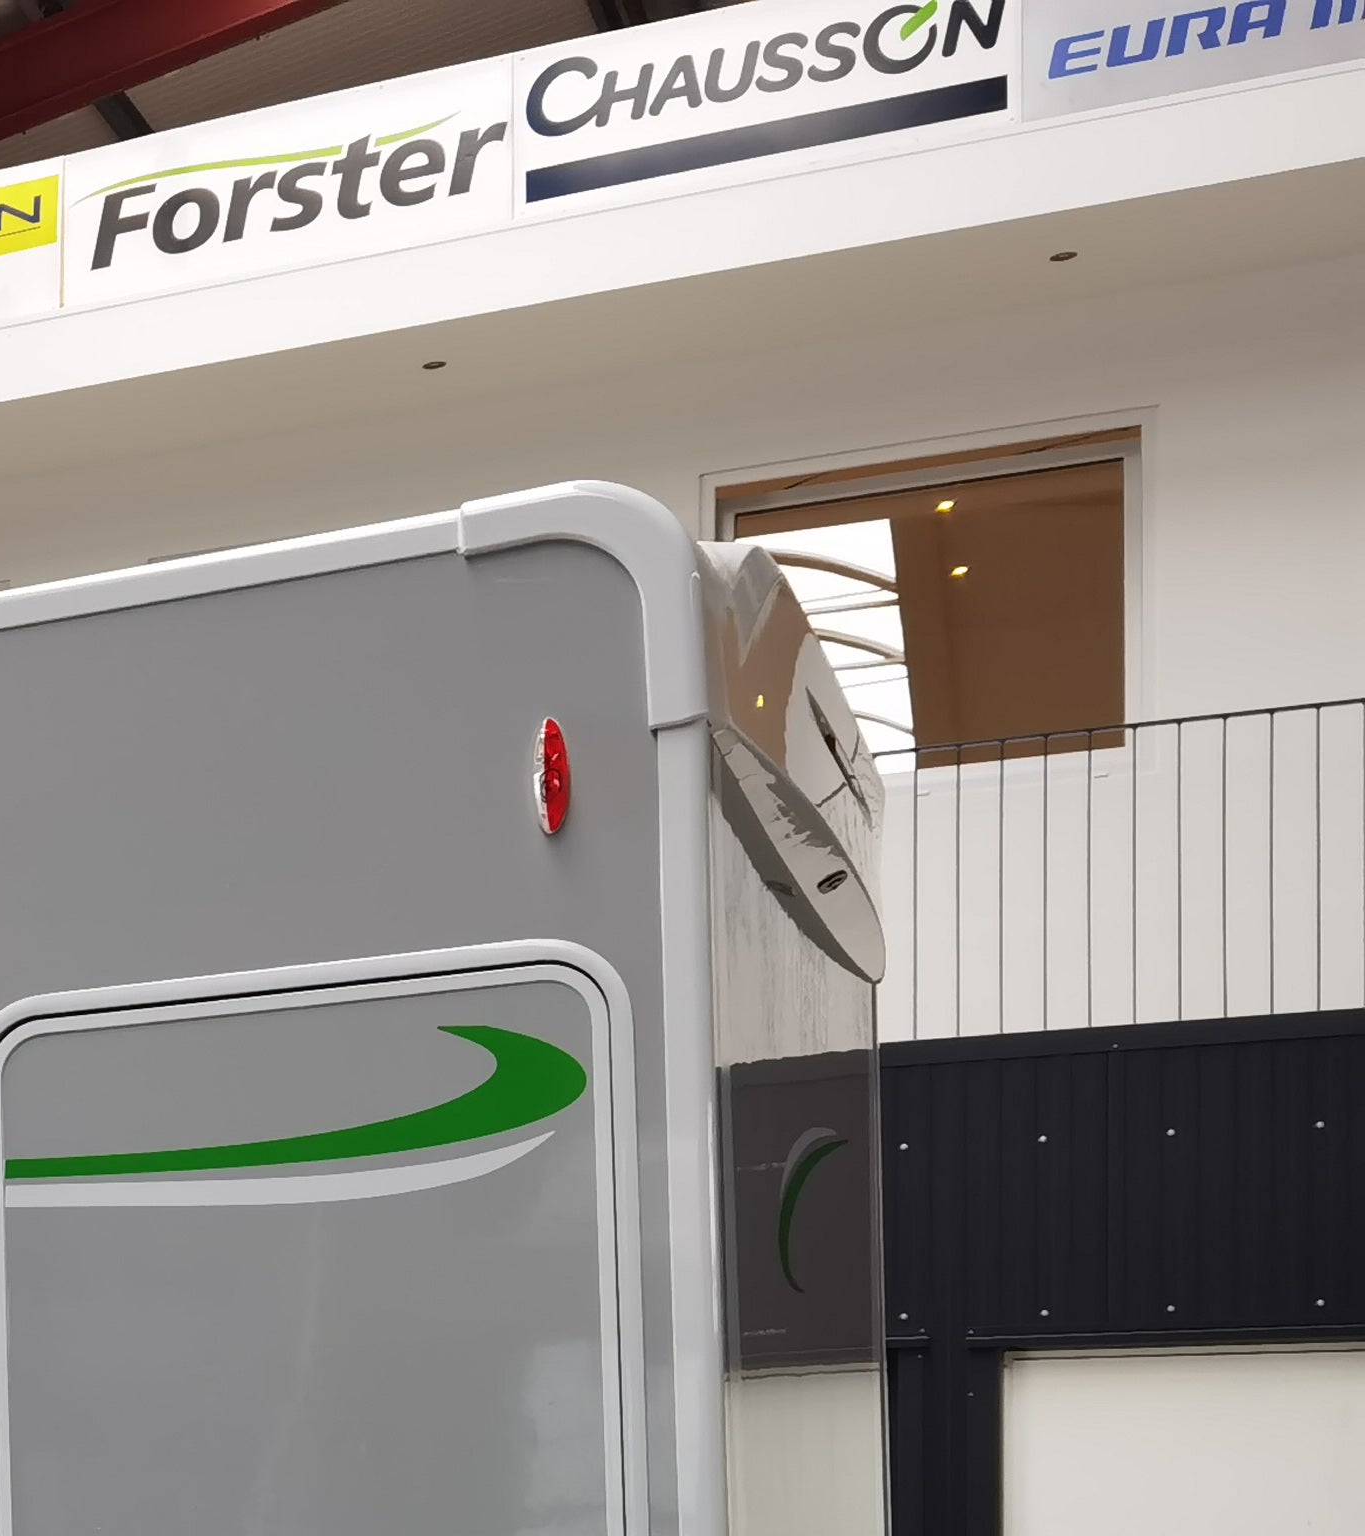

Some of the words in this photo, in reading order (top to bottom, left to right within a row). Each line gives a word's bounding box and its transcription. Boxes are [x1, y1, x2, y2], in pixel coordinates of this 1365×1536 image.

[525, 0, 1005, 137] CHAUSSON
[1048, 0, 1287, 80] EURA
[91, 121, 508, 271] Forster
